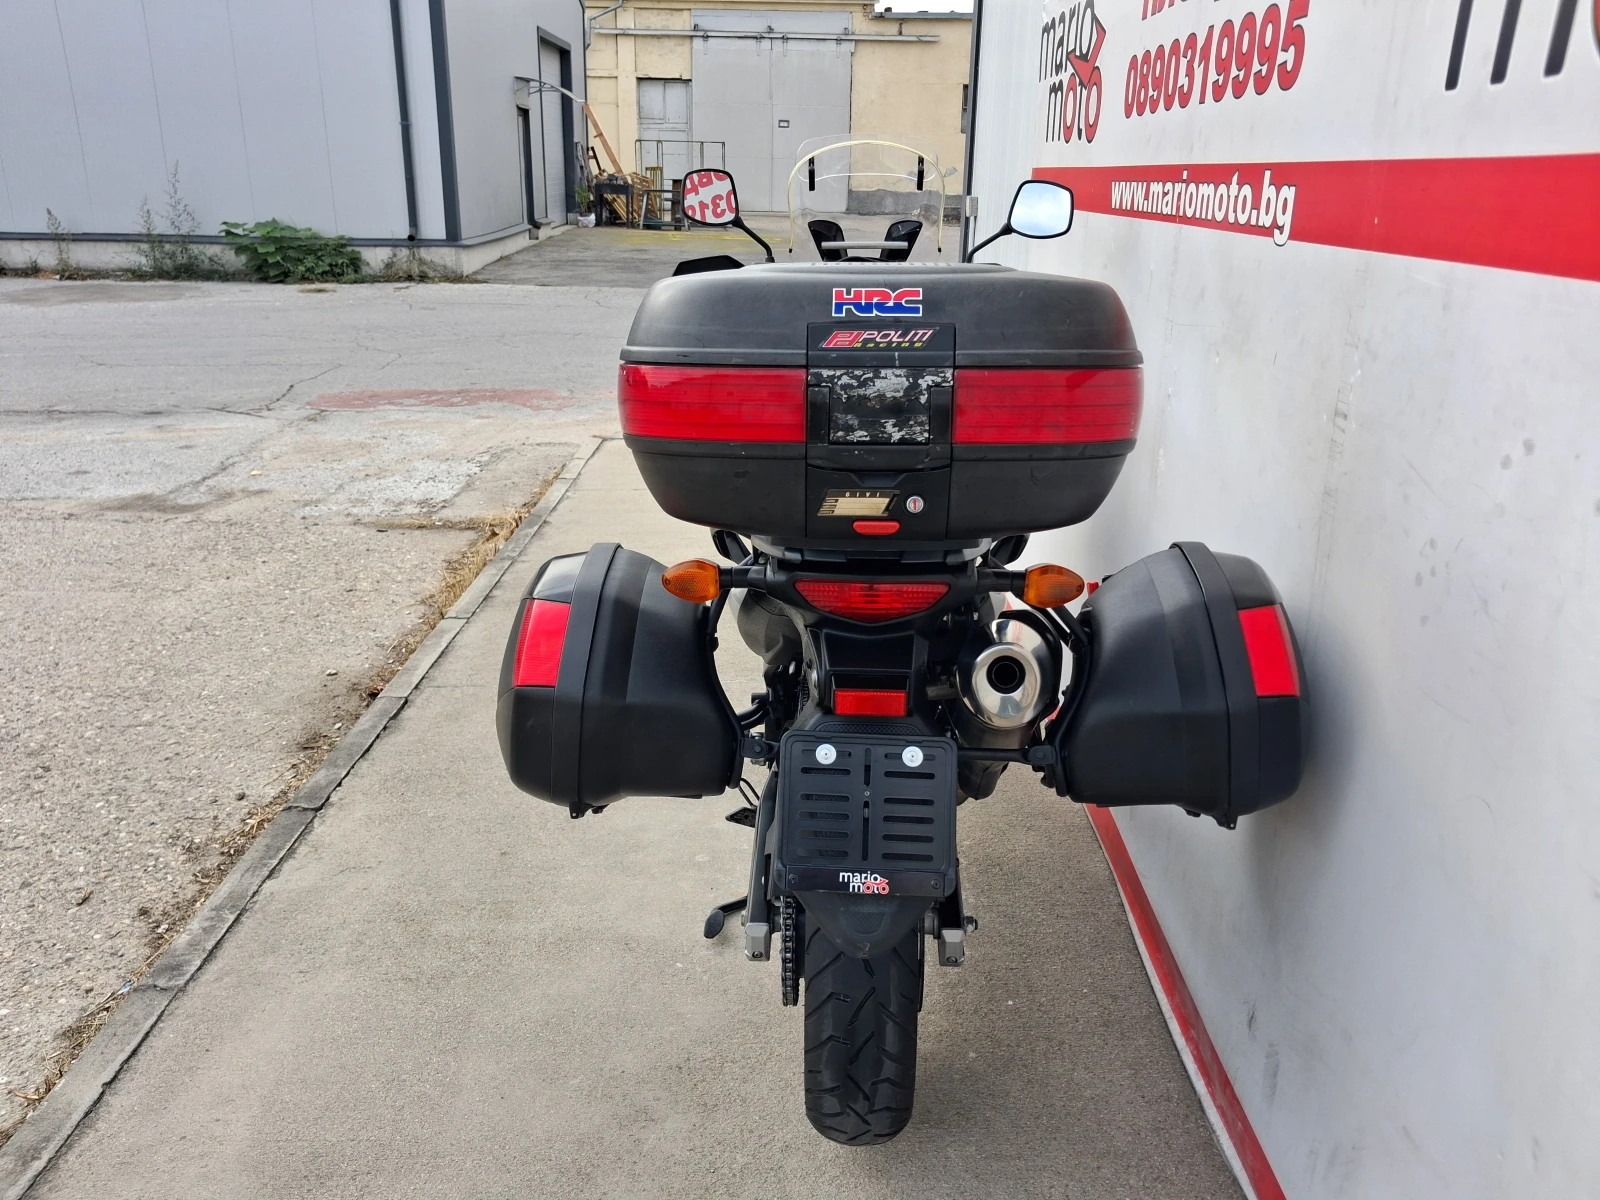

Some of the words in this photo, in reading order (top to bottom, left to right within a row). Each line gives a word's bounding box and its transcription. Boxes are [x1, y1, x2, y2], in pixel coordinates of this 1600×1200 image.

[1039, 0, 1095, 83] mario
[1124, 0, 1311, 119] 0890319995
[1045, 65, 1103, 144] moto
[1111, 168, 1297, 247] www.mariomoto.bg
[832, 288, 923, 317] HRC
[858, 329, 935, 343] POLITI
[839, 871, 881, 884] mario
[849, 881, 890, 895] moto
